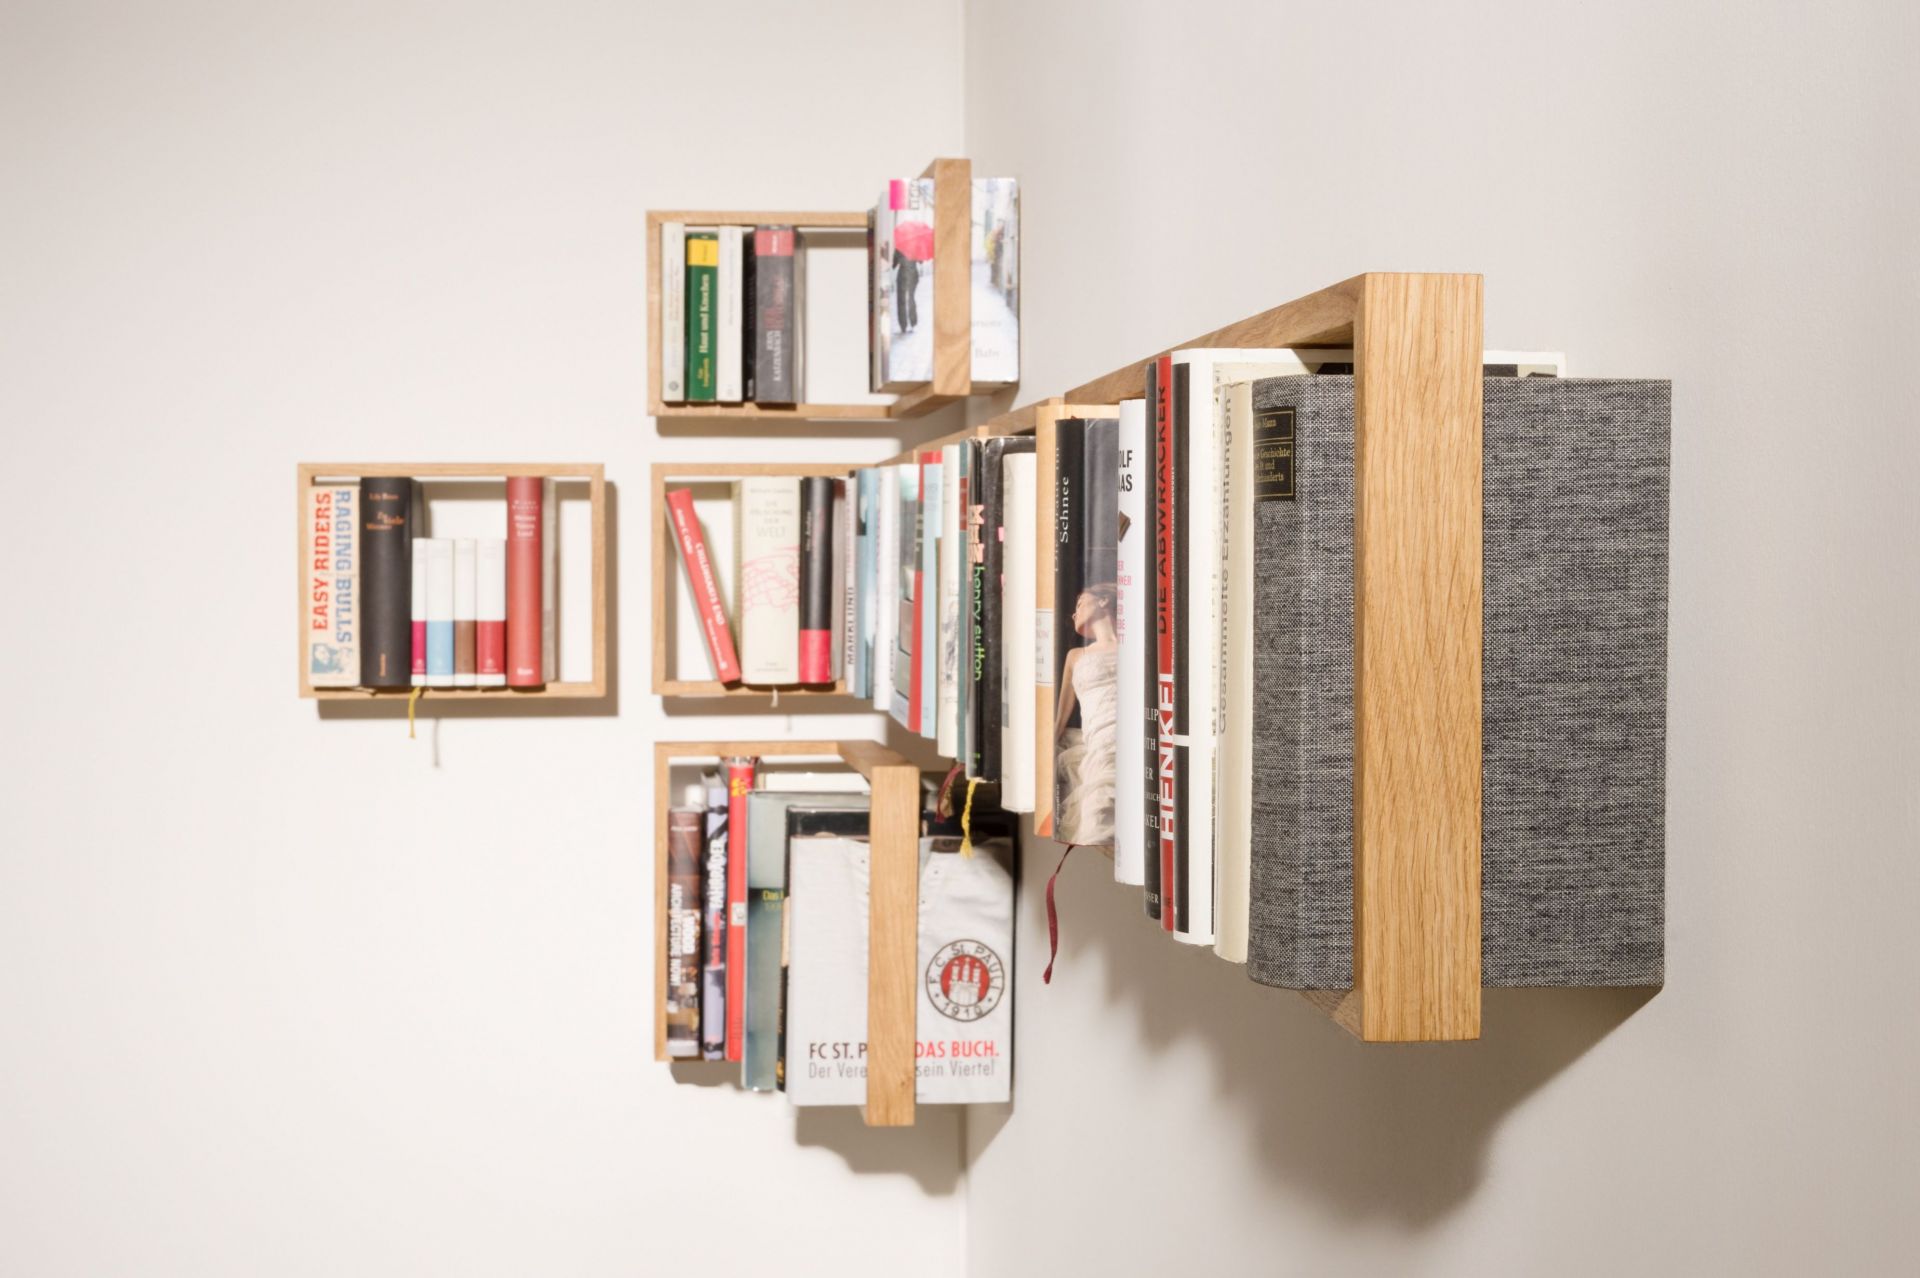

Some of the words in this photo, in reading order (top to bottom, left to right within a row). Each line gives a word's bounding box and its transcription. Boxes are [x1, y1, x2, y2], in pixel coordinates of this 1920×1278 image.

[701, 313, 709, 331] und
[1059, 476, 1070, 543] Schnee
[1158, 386, 1167, 577] ABWRACKER
[314, 492, 332, 571] RIDERS
[335, 490, 352, 571] RAGING
[312, 578, 329, 630] EASY
[335, 578, 352, 643] BULLS
[1158, 586, 1167, 635] DIE
[707, 839, 726, 909] FAHRRÄDER
[671, 883, 682, 957] ARCHITECTURE
[973, 945, 1001, 990] PAULI
[808, 1062, 831, 1079] Der
[837, 1062, 867, 1078] Vere
[950, 1059, 995, 1077] Viertel
[809, 1042, 828, 1060] FC
[833, 1042, 854, 1060] ST.
[951, 1040, 999, 1058] BUCH.
